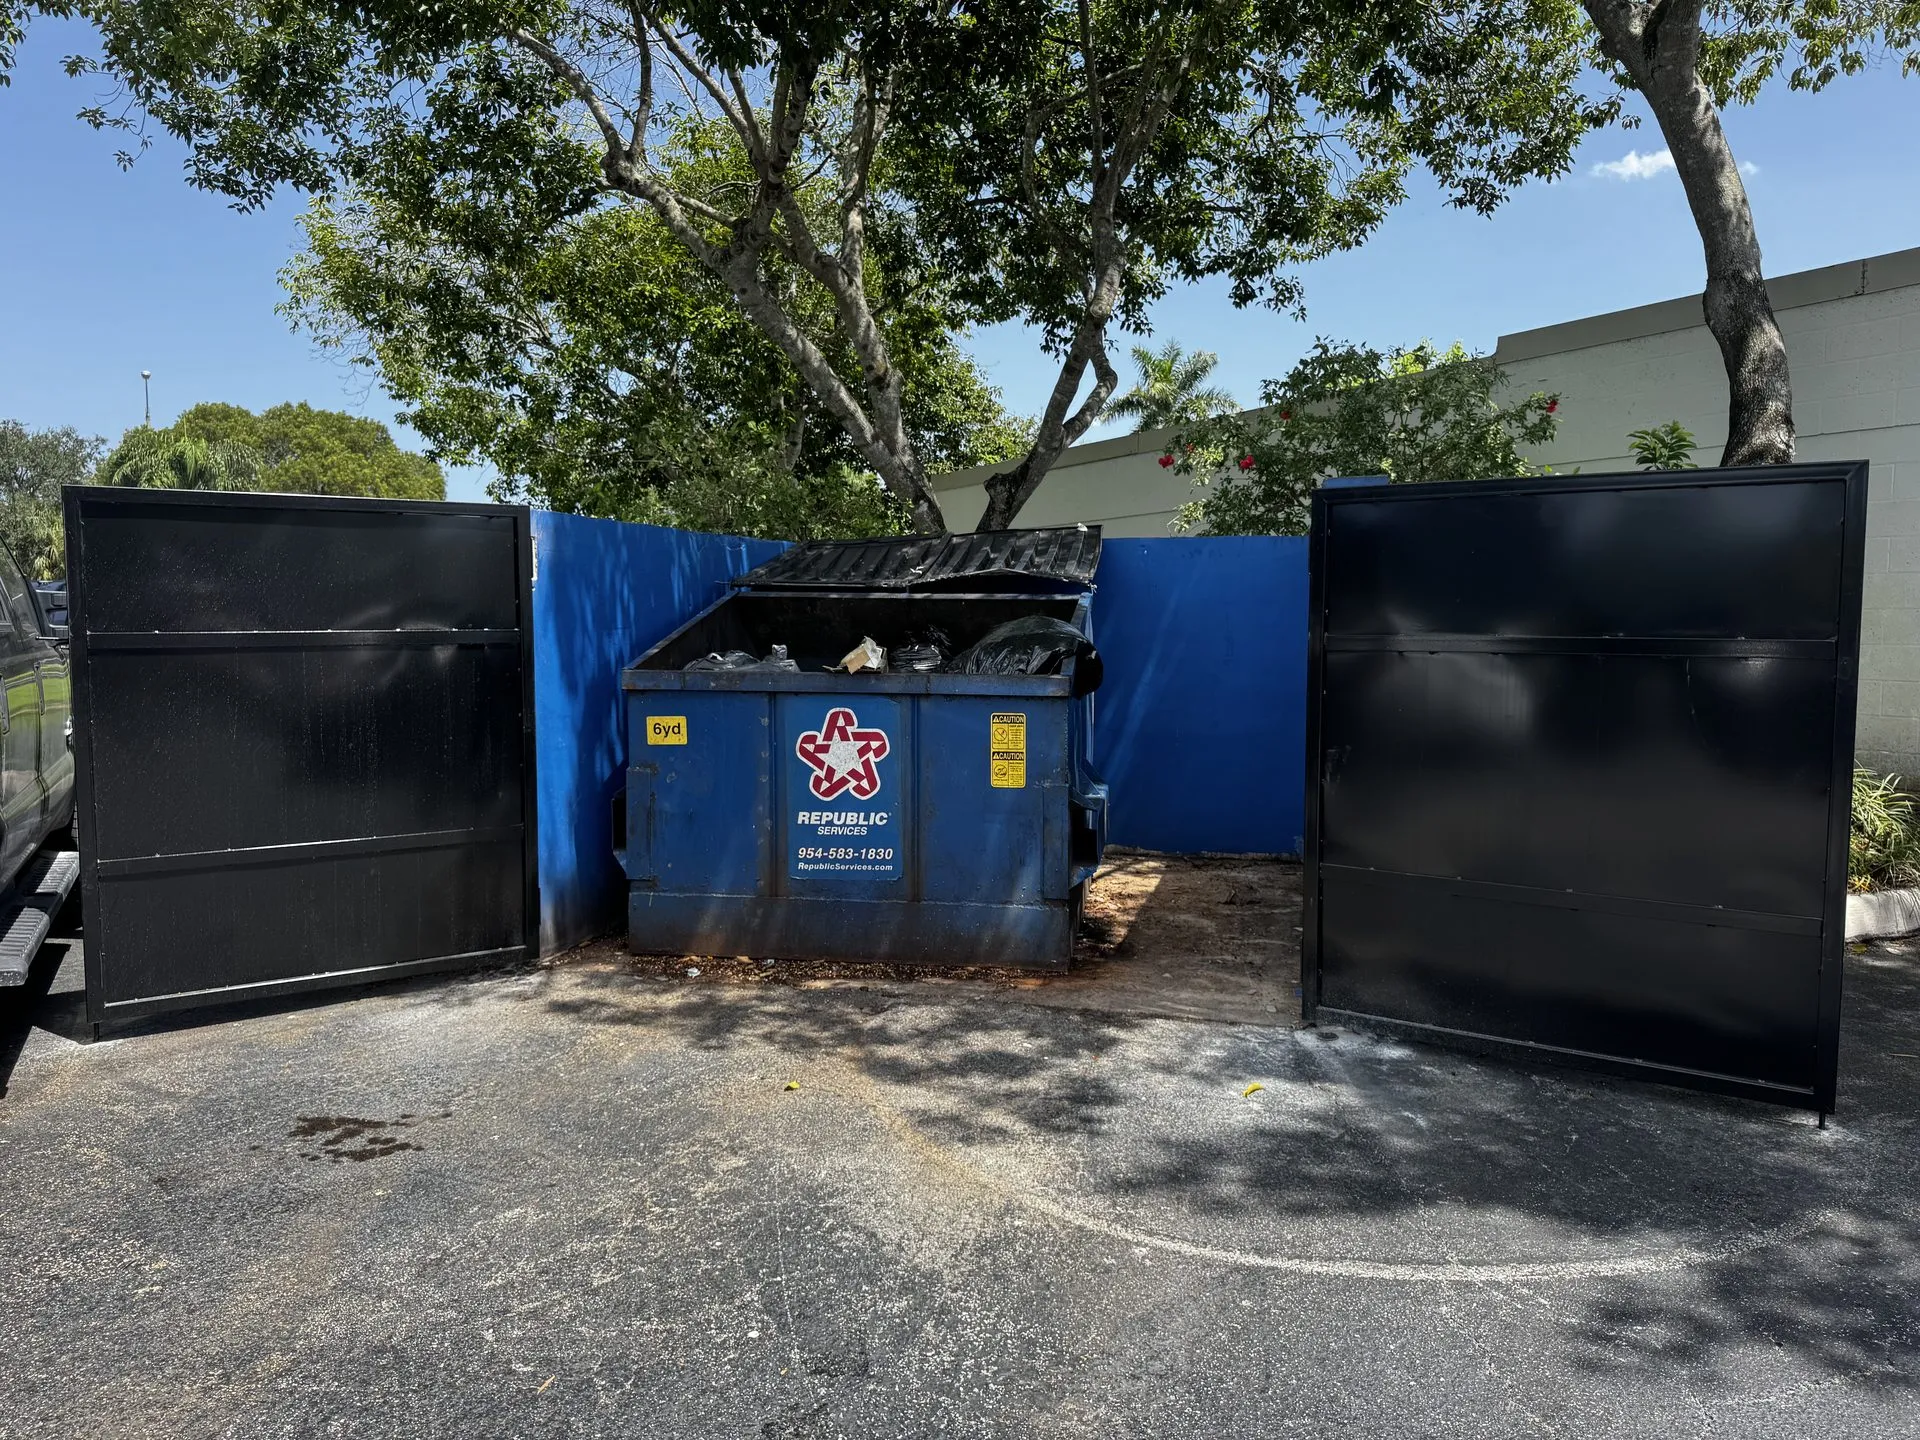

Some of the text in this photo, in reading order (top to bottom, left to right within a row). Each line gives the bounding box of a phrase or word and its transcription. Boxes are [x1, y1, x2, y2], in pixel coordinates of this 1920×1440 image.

[999, 715, 1024, 723] CAUTION
[653, 722, 681, 738] 6yd
[999, 752, 1024, 760] CAUTION
[797, 811, 888, 826] REPUBLIC
[817, 826, 868, 836] SERVICES
[798, 847, 893, 860] 954-583-1830
[798, 862, 893, 871] RepublicServices.com
